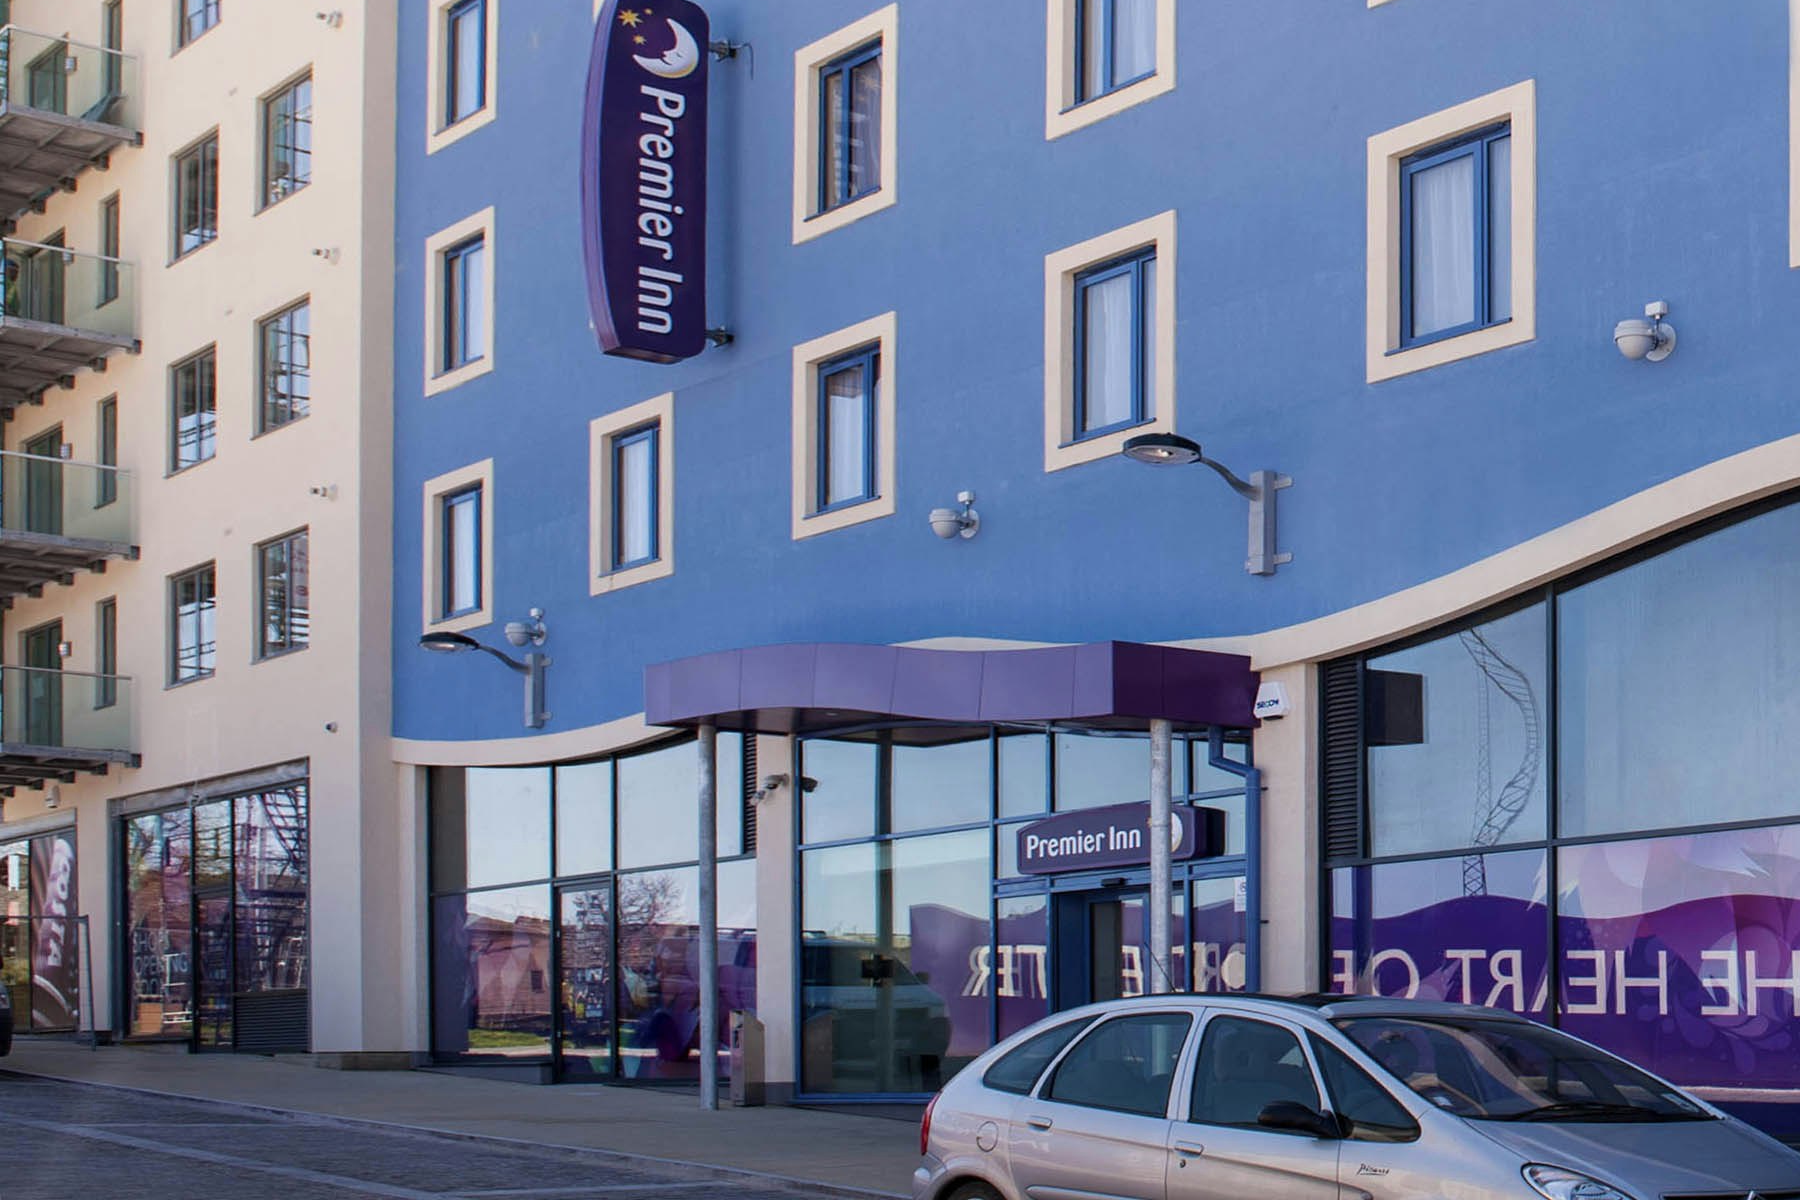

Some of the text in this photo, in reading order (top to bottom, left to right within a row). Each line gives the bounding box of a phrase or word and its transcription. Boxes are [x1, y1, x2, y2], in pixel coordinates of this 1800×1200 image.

[637, 84, 686, 335] Premier Inn
[1026, 825, 1141, 859] Premier Inn
